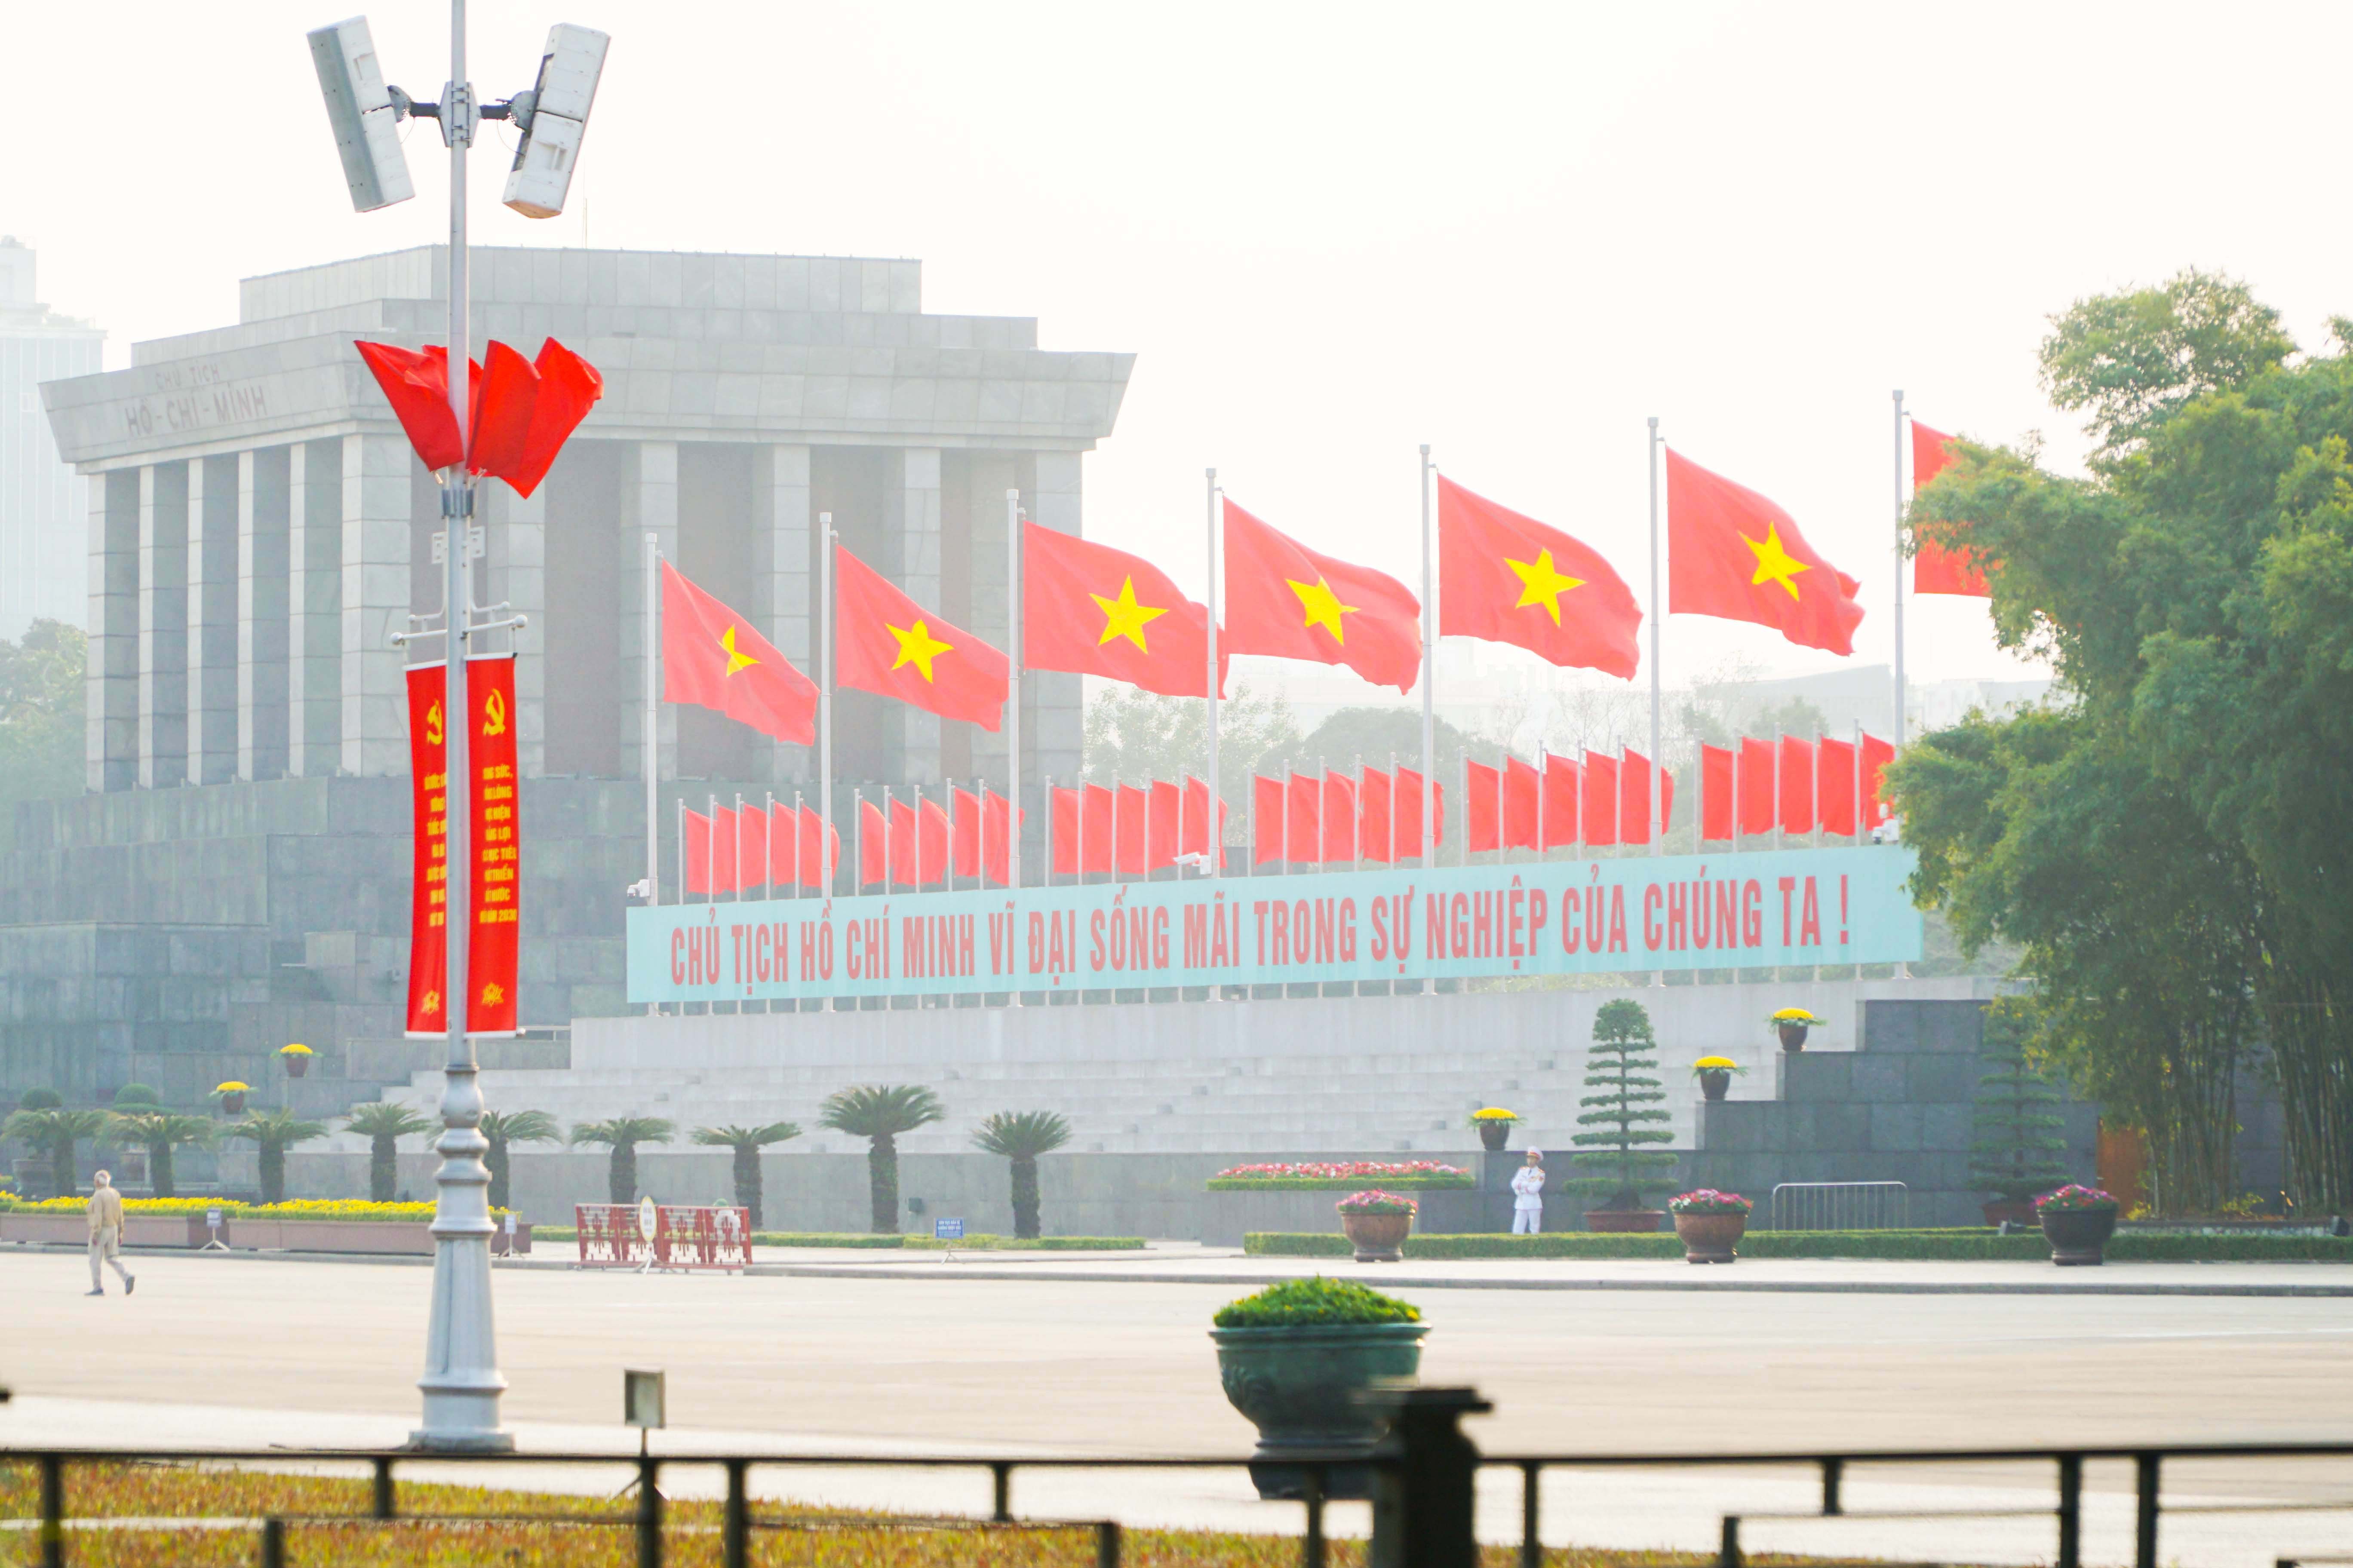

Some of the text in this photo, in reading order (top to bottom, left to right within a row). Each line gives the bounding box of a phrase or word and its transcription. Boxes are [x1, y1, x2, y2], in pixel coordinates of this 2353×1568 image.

[672, 908, 719, 985] CHỦ
[732, 924, 787, 994] TỊCH
[802, 900, 832, 980] HỒ
[847, 905, 889, 979] CHÍ
[903, 915, 974, 977] MINH
[989, 902, 1014, 974] VĨ
[1029, 910, 1075, 984] ĐẠI
[1091, 886, 1168, 971] SỐNG
[1185, 892, 1238, 968] MÃI
[1254, 898, 1355, 965] TRONG
[1371, 886, 1413, 973] SỰ
[1427, 875, 1546, 969] NGHIỆP
[1562, 864, 1627, 954] CỦA
[1644, 866, 1761, 951] CHÚNG
[1779, 876, 1820, 946] TA
